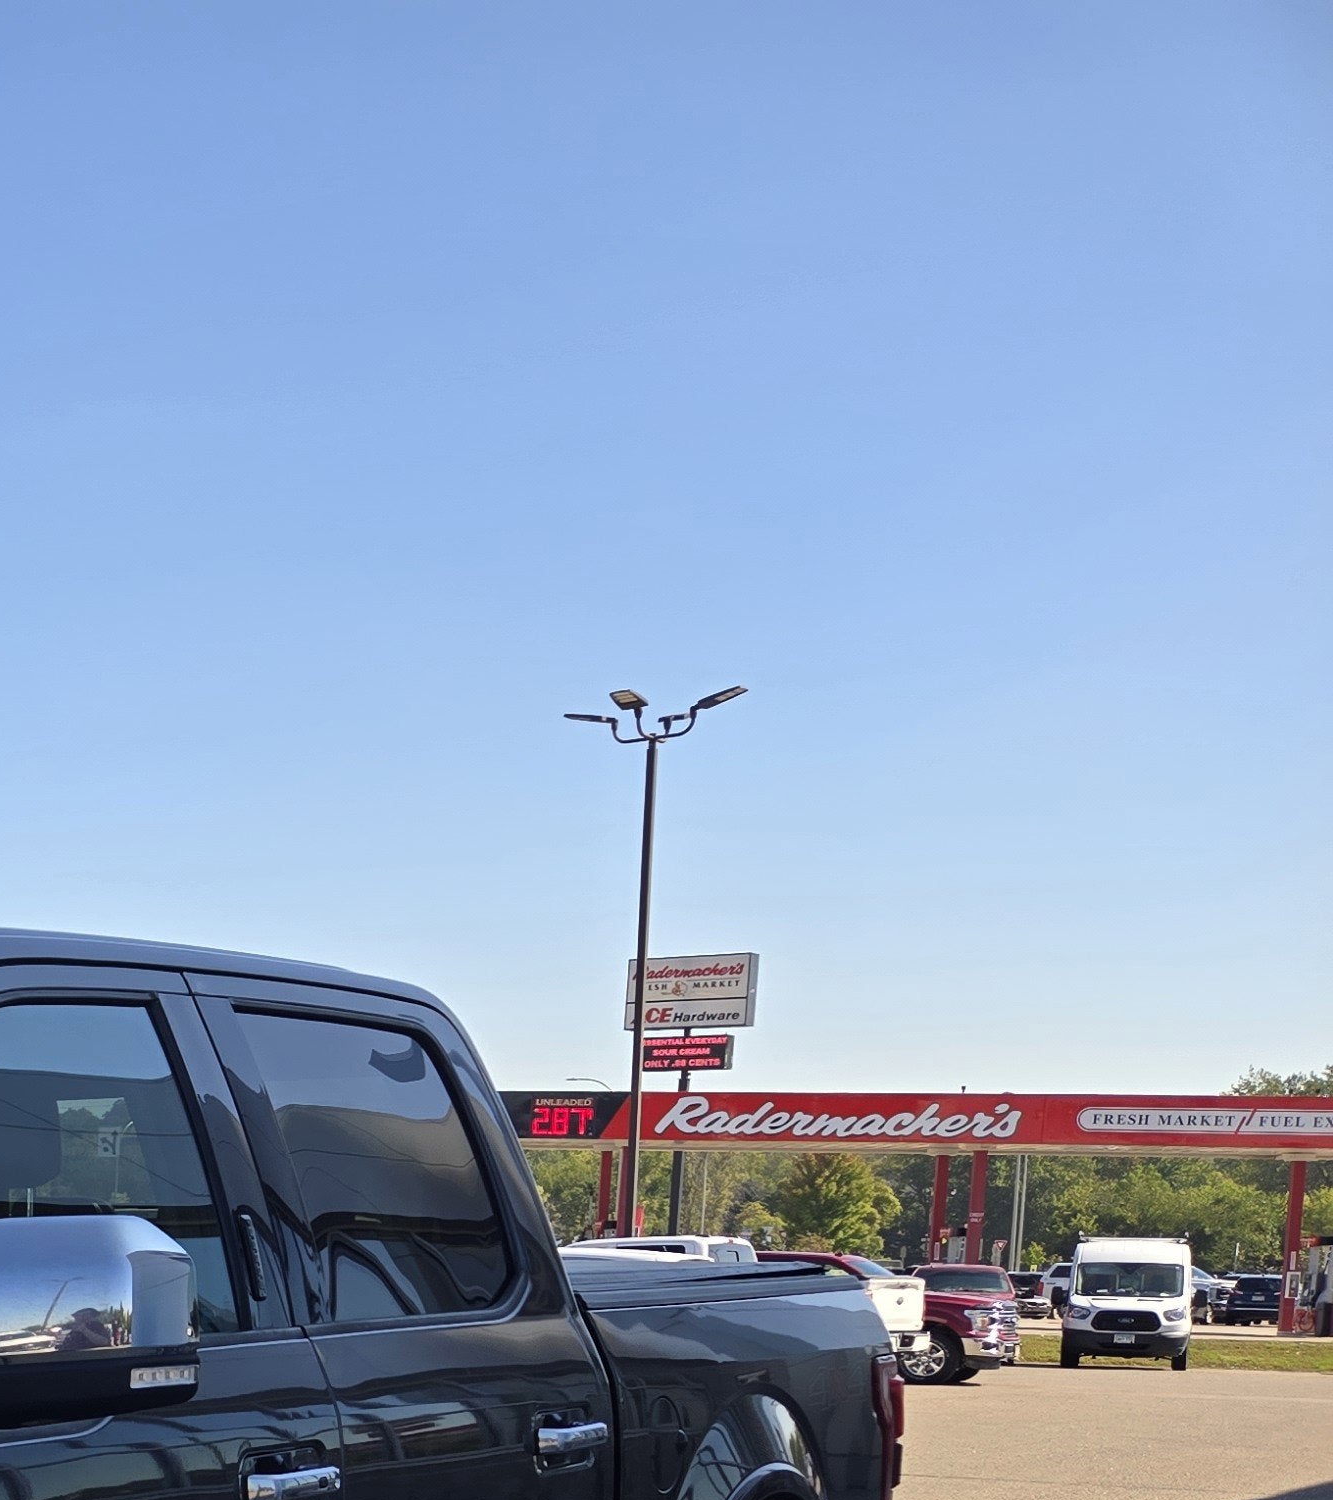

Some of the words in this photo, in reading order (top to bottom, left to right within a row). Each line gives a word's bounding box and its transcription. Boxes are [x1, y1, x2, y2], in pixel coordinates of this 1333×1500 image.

[633, 963, 745, 980] adermacher's
[693, 980, 740, 989] MARKET
[631, 1007, 674, 1024] CE
[673, 1010, 740, 1023] Hardware
[535, 1098, 592, 1106] UNLEADED
[654, 1096, 1022, 1138] Radermacher's
[1092, 1113, 1150, 1126] FRESH
[1157, 1114, 1236, 1127] MARKET
[1259, 1116, 1305, 1128] FUEL
